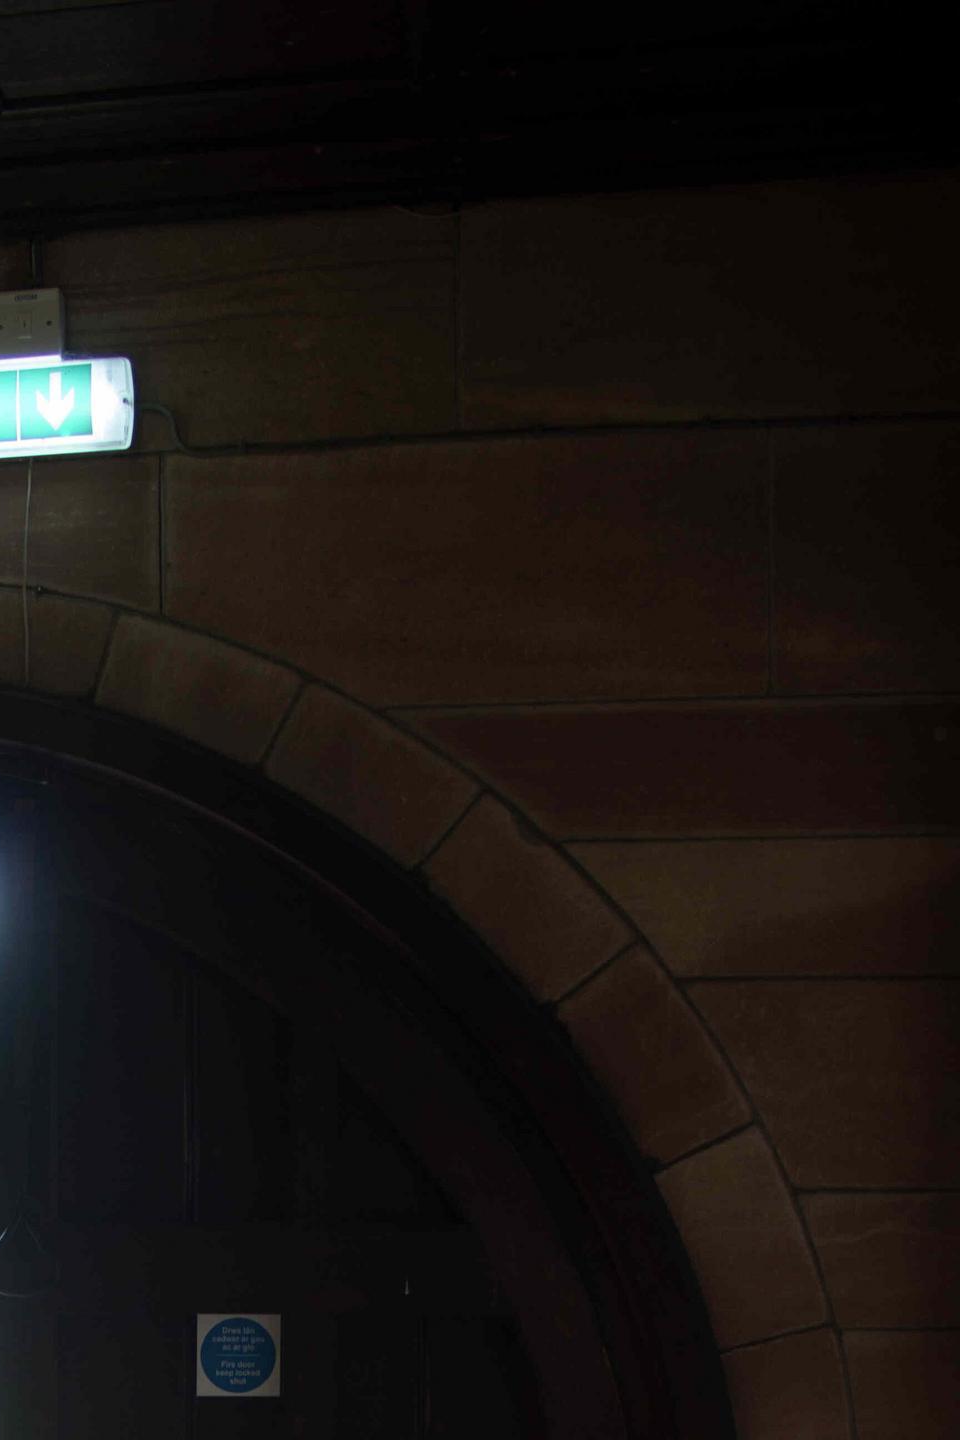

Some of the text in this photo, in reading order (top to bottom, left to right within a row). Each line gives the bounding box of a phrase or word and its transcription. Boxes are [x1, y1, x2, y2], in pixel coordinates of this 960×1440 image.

[221, 1360, 255, 1368] Fire door
[216, 1369, 261, 1378] keep locked
[229, 1376, 247, 1385] shut
